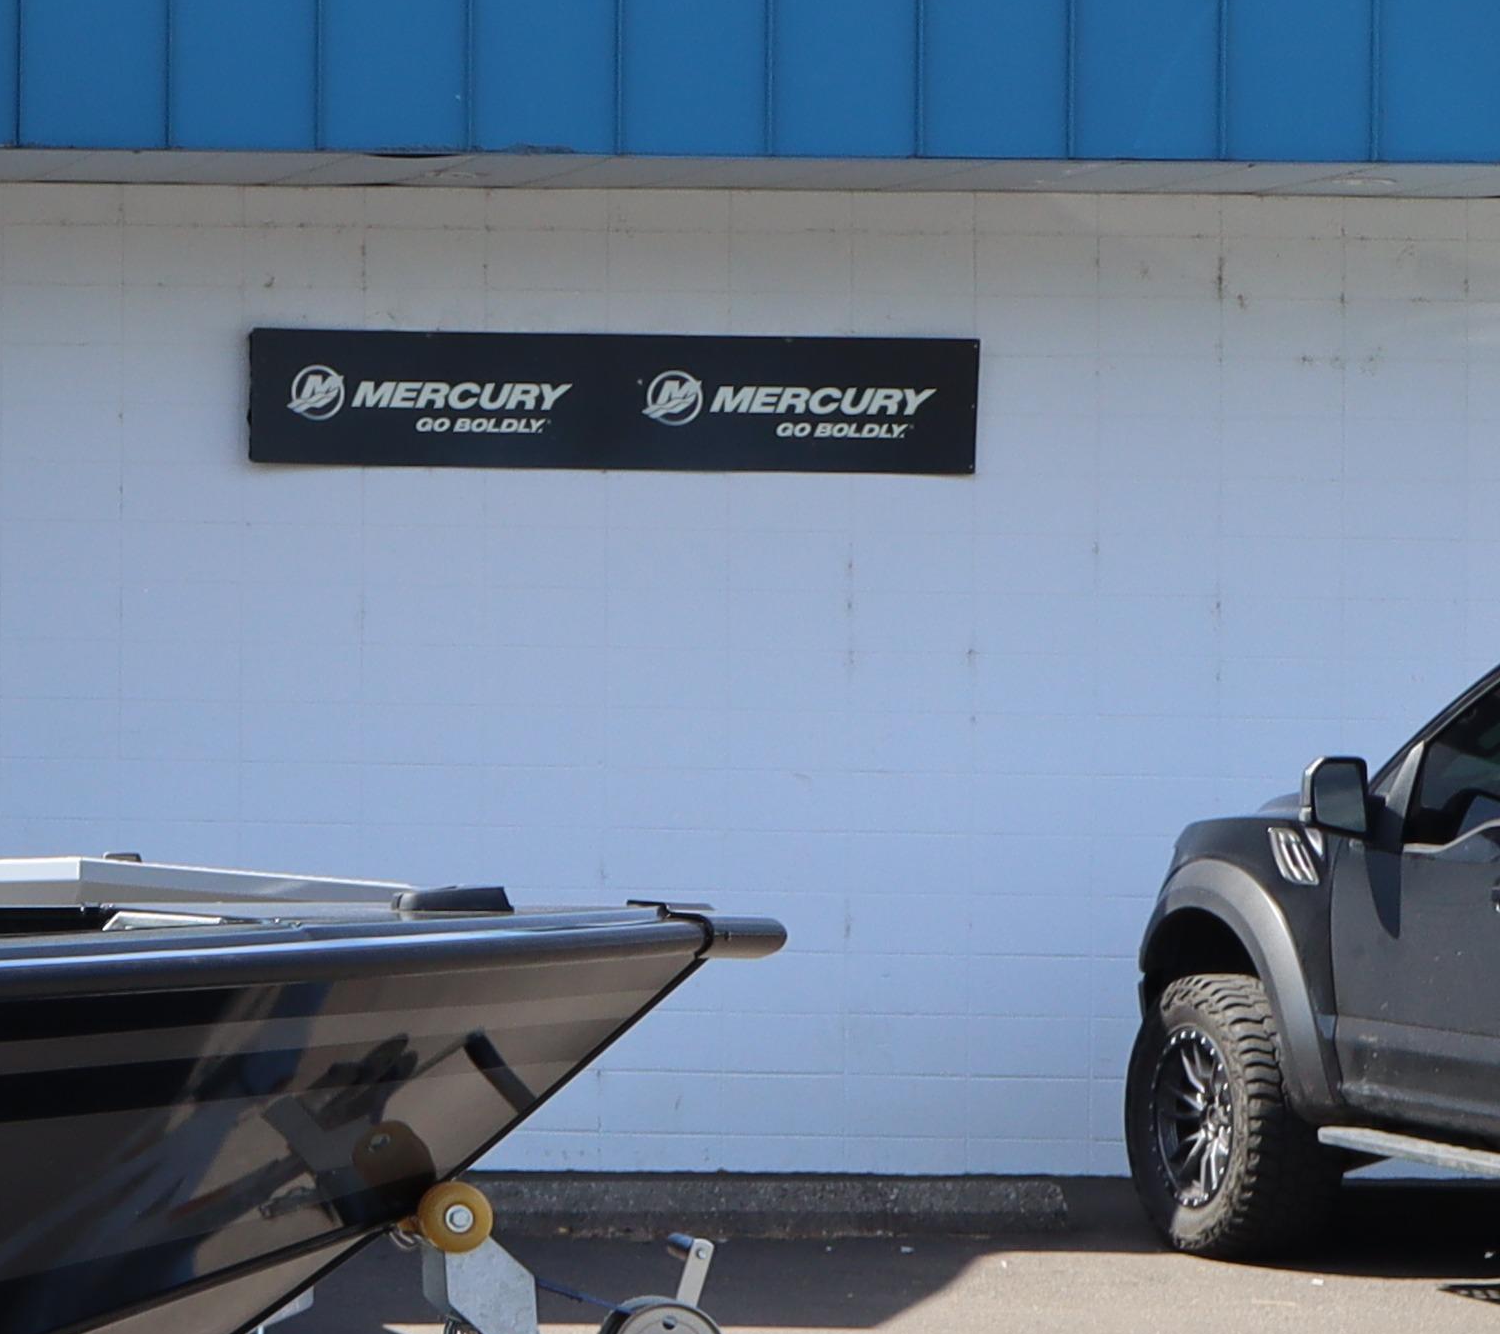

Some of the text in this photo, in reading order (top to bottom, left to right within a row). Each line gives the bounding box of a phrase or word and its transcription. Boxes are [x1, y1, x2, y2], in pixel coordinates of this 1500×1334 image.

[351, 380, 573, 411] MERCURY
[709, 386, 937, 416] MERCURY
[415, 418, 450, 433] GO
[775, 422, 811, 437] GO
